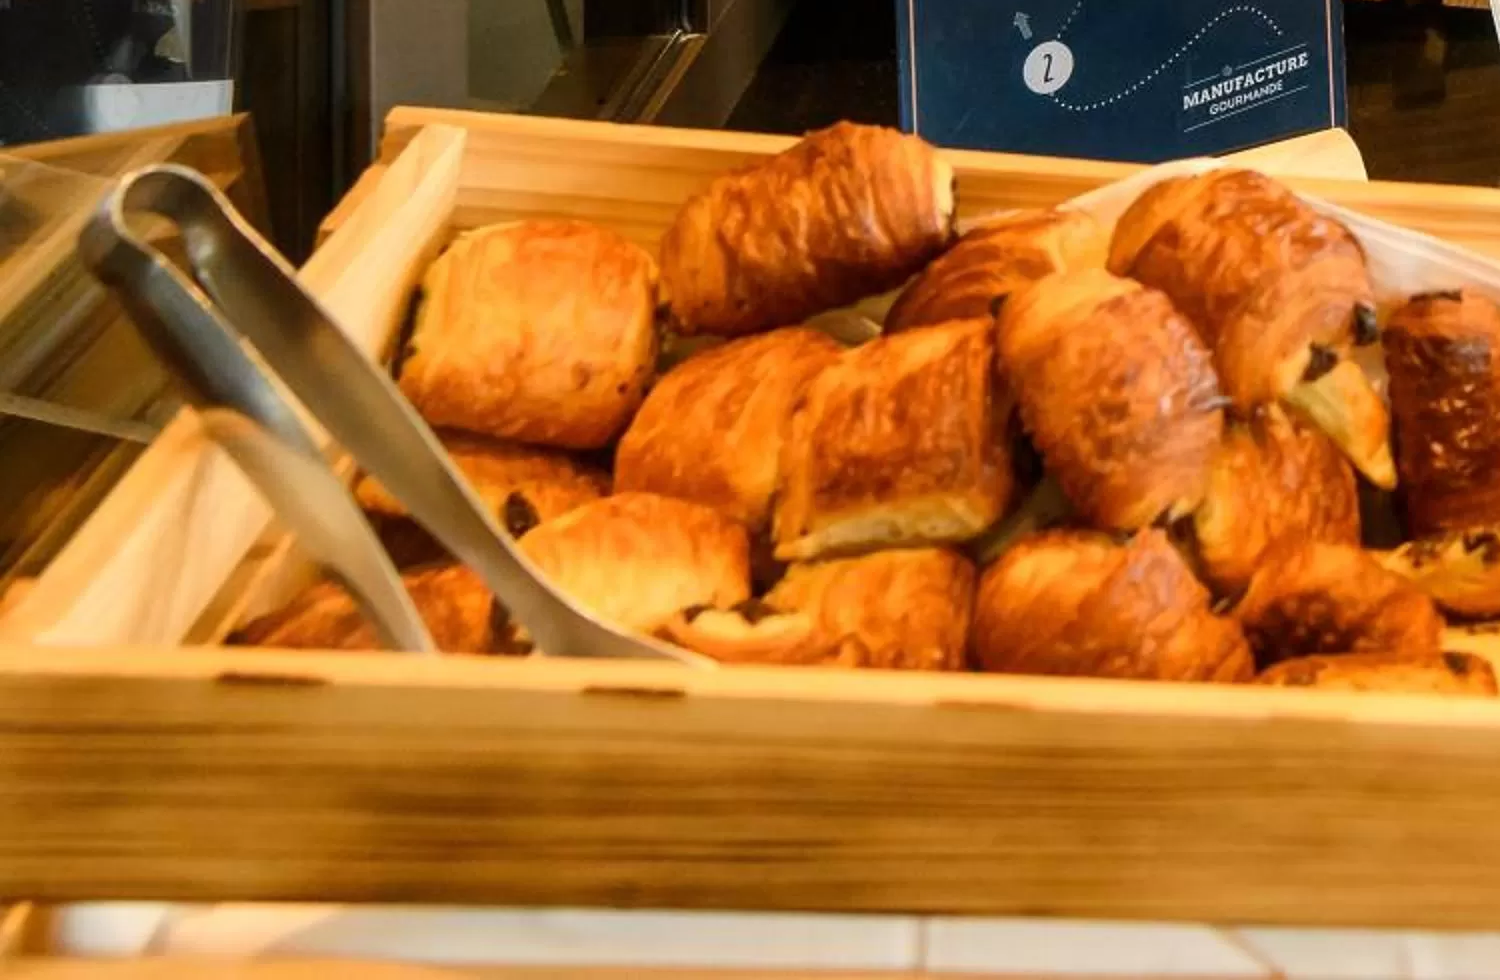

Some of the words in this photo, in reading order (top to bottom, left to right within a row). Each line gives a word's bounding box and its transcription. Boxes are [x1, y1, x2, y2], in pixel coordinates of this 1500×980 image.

[1043, 53, 1055, 84] 2
[1183, 51, 1309, 111] MANUFACTURE
[1209, 79, 1284, 115] GOURMANDE
